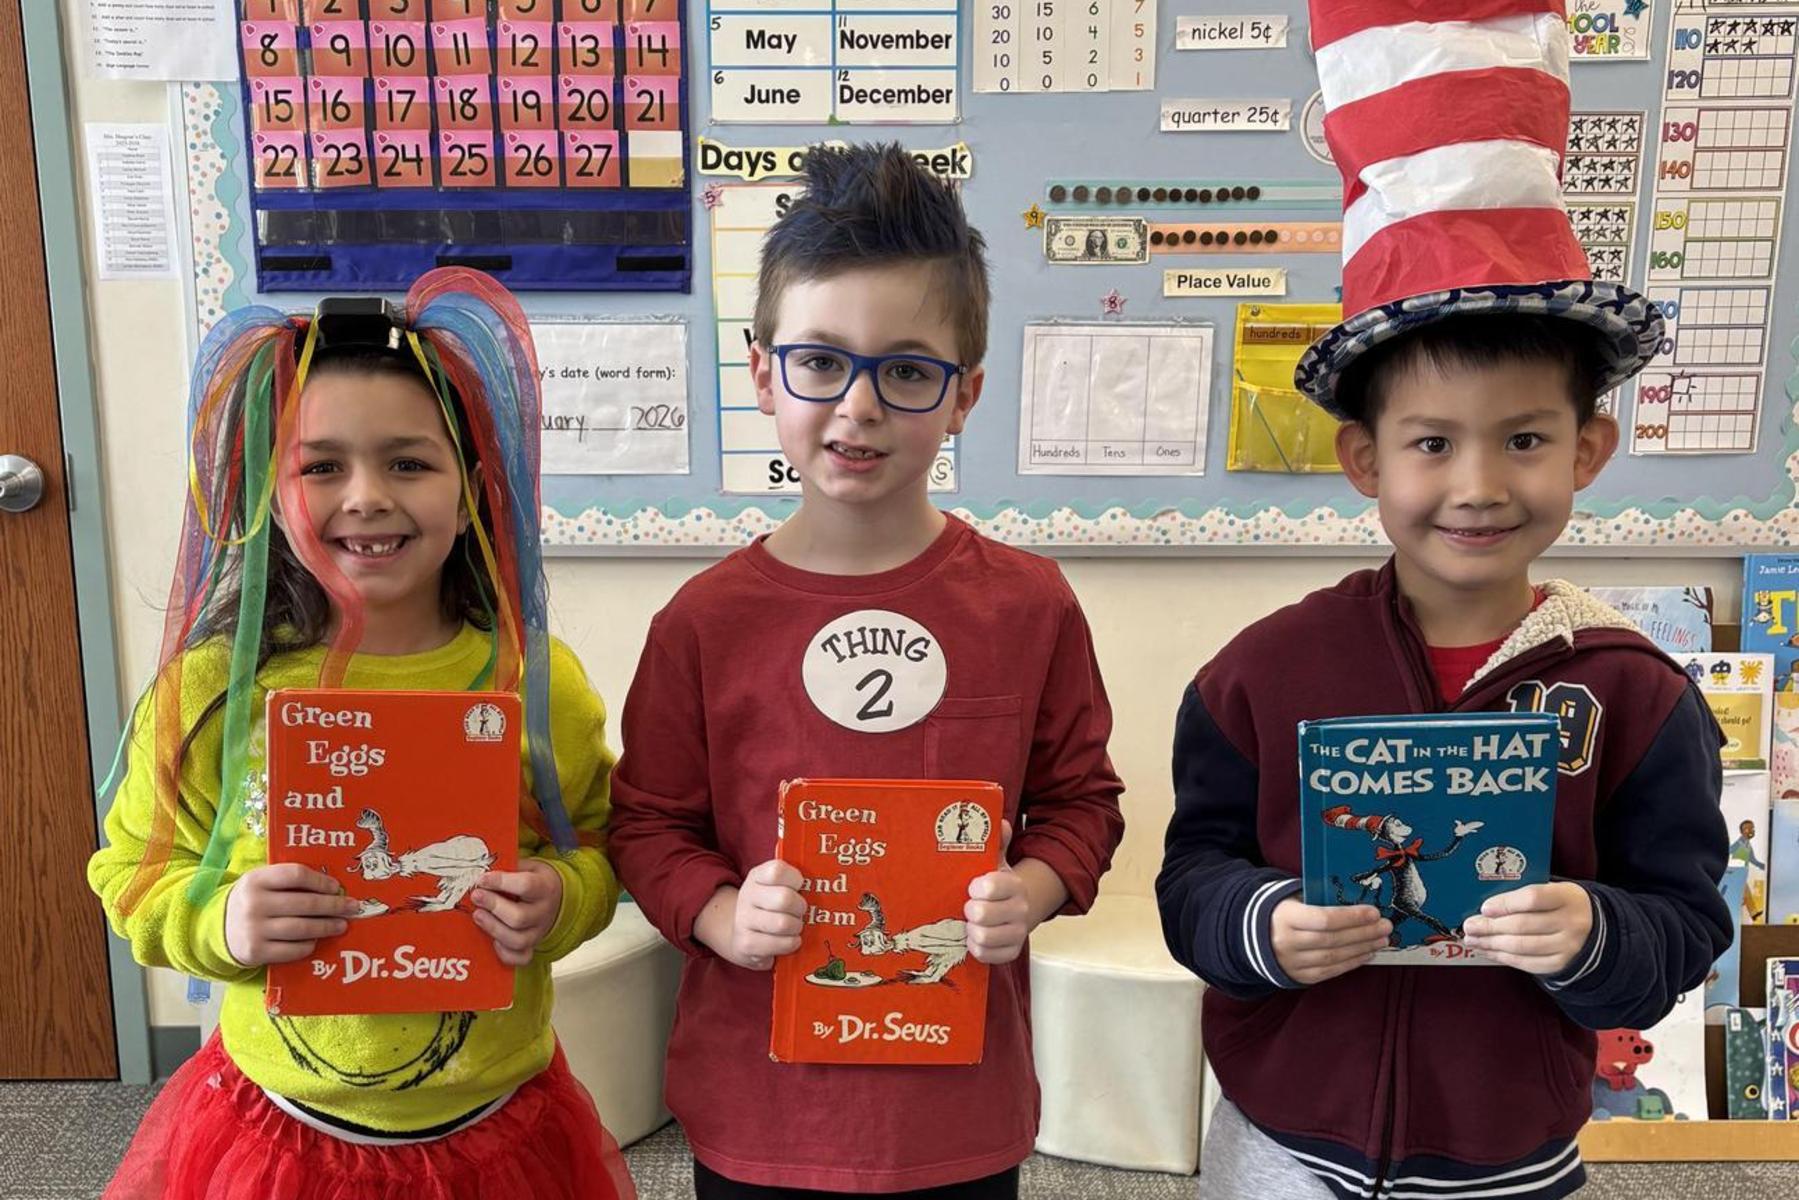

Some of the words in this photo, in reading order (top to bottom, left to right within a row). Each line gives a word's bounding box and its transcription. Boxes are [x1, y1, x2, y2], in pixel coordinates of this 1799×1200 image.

[992, 5, 1010, 20] 30
[1037, 2, 1053, 17] 15
[1089, 1, 1099, 15] 6
[1135, 0, 1144, 14] 7
[710, 17, 721, 30] 5
[992, 29, 1010, 44] 20
[1037, 26, 1053, 41] 10
[1088, 25, 1098, 39] 4
[1134, 23, 1144, 37] 5
[1192, 21, 1244, 40] nickel
[1251, 22, 1272, 44] 5¢
[260, 33, 278, 66] 8
[330, 34, 351, 66] 9
[385, 34, 415, 67] 10
[453, 33, 471, 65] 11
[511, 33, 539, 67] 12
[571, 34, 600, 67] 13
[638, 34, 669, 67] 14
[745, 30, 797, 54] May
[840, 29, 952, 50] November
[1573, 33, 1620, 54] YEAR
[1675, 28, 1702, 51] 110
[994, 53, 1010, 68] 10
[1042, 50, 1052, 65] 5
[1089, 49, 1098, 64] 2
[1134, 48, 1143, 62] 3
[714, 71, 724, 84] 6
[837, 71, 850, 82] 12
[1000, 77, 1010, 91] 0
[1042, 74, 1052, 89] 0
[1087, 73, 1098, 87] 0
[1136, 72, 1140, 86] 1
[1667, 70, 1700, 89] 120
[265, 90, 293, 122] 15
[321, 89, 351, 122] 16
[388, 90, 416, 122] 17
[449, 88, 478, 122] 18
[512, 90, 542, 122] 19
[567, 88, 609, 121] 20
[636, 89, 664, 122] 21
[744, 85, 800, 104] June
[839, 85, 953, 104] December
[1171, 108, 1240, 128] quarter
[1247, 106, 1280, 126] 25¢
[1663, 123, 1696, 142] 130
[262, 144, 298, 177] 22
[323, 142, 363, 176] 23
[382, 144, 423, 176] 24
[448, 144, 488, 176] 25
[514, 143, 553, 176] 26
[575, 144, 612, 177] 27
[701, 144, 776, 177] Days
[788, 153, 802, 170] o
[914, 149, 968, 175] eek
[1660, 161, 1691, 180] 140
[1655, 212, 1687, 230] 150
[1649, 251, 1682, 269] 160
[1177, 275, 1222, 288] Place
[1226, 275, 1272, 288] Value
[1250, 325, 1301, 339] hundreds
[561, 367, 590, 379] date
[595, 367, 630, 380] (word
[636, 367, 676, 380] form):
[1640, 386, 1671, 404] 190
[541, 415, 584, 442] uary
[631, 404, 685, 428] 2026
[1636, 425, 1667, 439] 200
[1032, 445, 1081, 458] Hundreds
[1102, 446, 1126, 458] Tens
[1156, 446, 1181, 457] Ones
[821, 626, 931, 664] THING
[855, 669, 894, 721] 2
[281, 702, 373, 729] Green
[306, 740, 386, 777] Eggs
[1309, 743, 1341, 758] THE
[1344, 737, 1413, 766] CAT
[1413, 746, 1431, 758] IN
[1436, 745, 1468, 758] THE
[1472, 731, 1550, 761] HAT
[1309, 768, 1435, 795] COMES
[1446, 766, 1550, 796] BACK
[284, 787, 345, 810] and
[798, 800, 877, 824] Green
[286, 824, 356, 848] Ham
[819, 833, 887, 866] Eggs
[1446, 943, 1475, 958] Dr.
[311, 960, 338, 978] By
[340, 949, 389, 984] Dr.
[392, 945, 471, 981] Seuss
[812, 1021, 834, 1039] By
[837, 1014, 879, 1044] Dr.
[882, 1012, 951, 1045] Seuss
